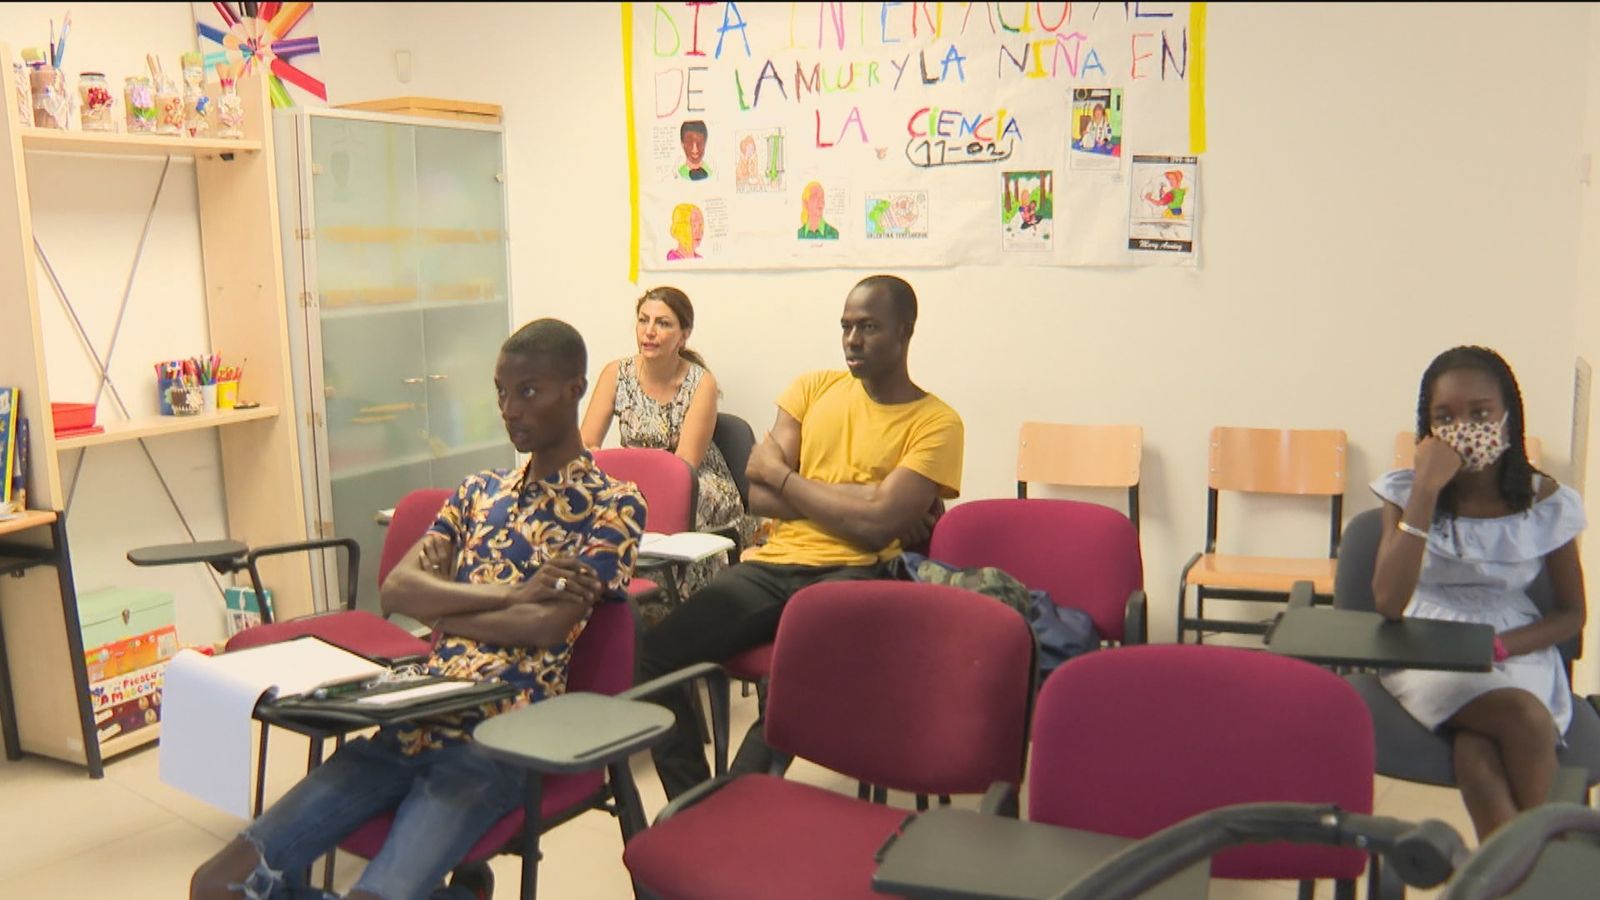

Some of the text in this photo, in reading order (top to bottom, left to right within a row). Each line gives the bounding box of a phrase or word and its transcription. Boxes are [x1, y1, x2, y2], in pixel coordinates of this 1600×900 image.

[653, 2, 751, 59] DIA
[654, 66, 708, 118] DE
[735, 59, 788, 111] LA
[890, 53, 910, 91] Y
[919, 44, 966, 85] LA
[999, 31, 1106, 80] NIÑA
[1130, 27, 1187, 81] EN
[815, 105, 1023, 148] LA CIENCIA
